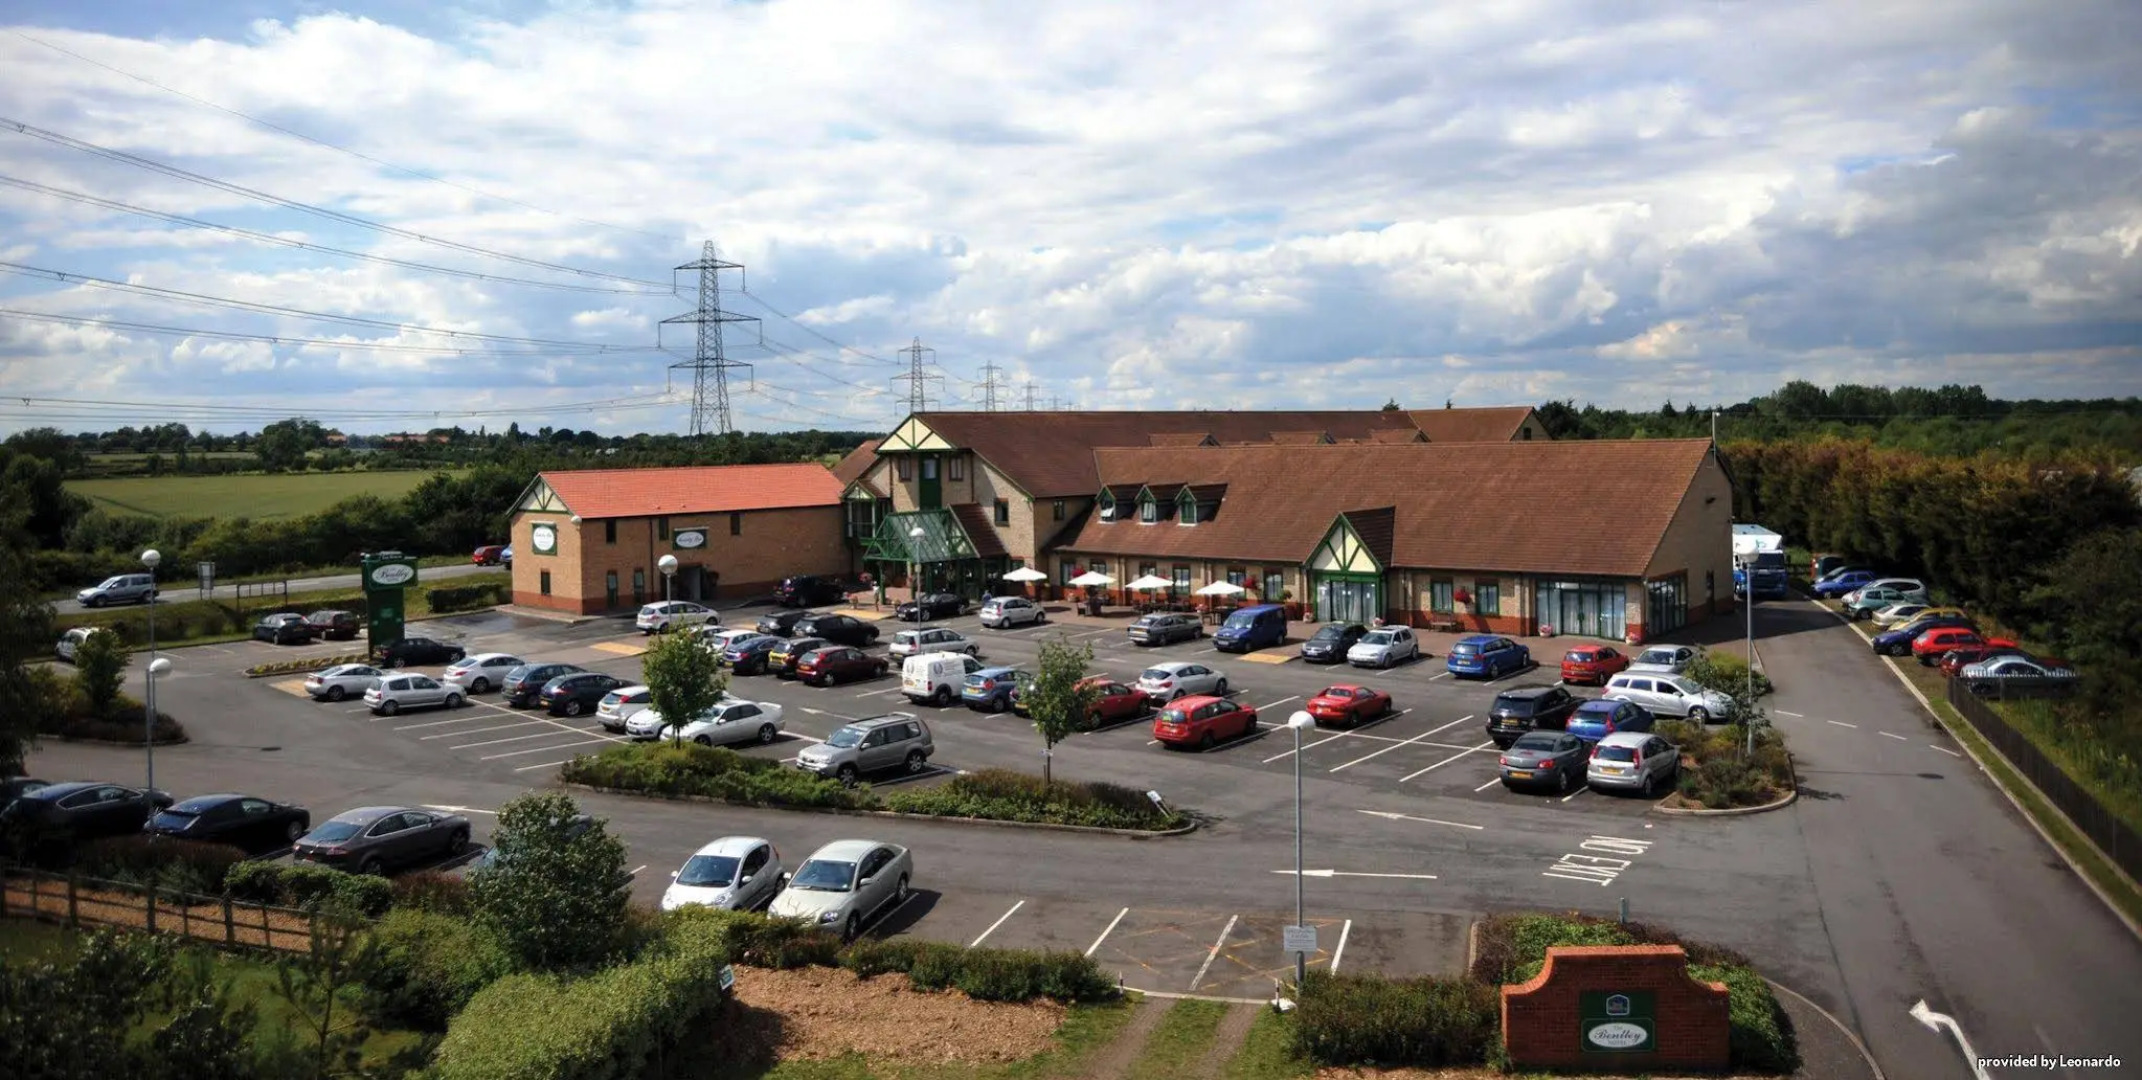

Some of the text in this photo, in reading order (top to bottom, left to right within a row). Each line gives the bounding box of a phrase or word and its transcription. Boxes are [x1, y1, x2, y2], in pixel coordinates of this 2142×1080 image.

[1542, 834, 1654, 887] NO EXIT
[1594, 1029, 1641, 1043] Bentley
